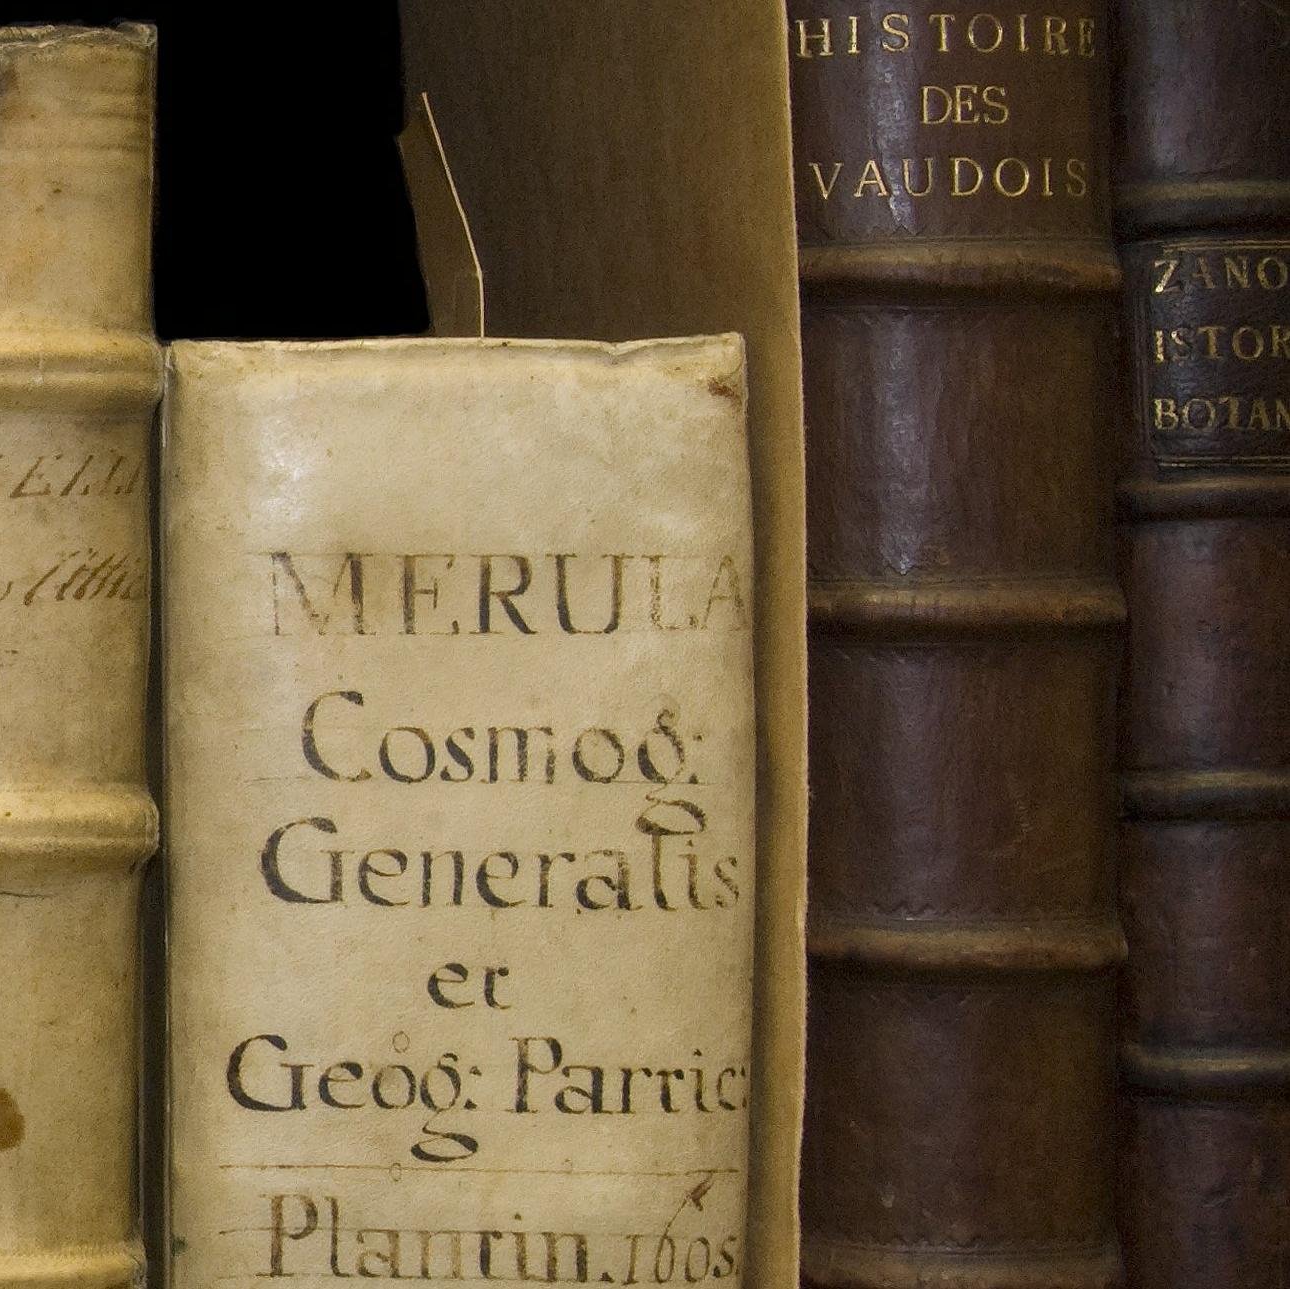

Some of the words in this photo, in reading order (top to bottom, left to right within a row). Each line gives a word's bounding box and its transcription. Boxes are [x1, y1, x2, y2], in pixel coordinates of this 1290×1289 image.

[796, 13, 1095, 57] HISTOIRE
[922, 85, 1010, 125] DES
[809, 156, 1089, 200] VAUDOIS
[268, 551, 751, 637] MERULA
[260, 815, 742, 914] Generalis
